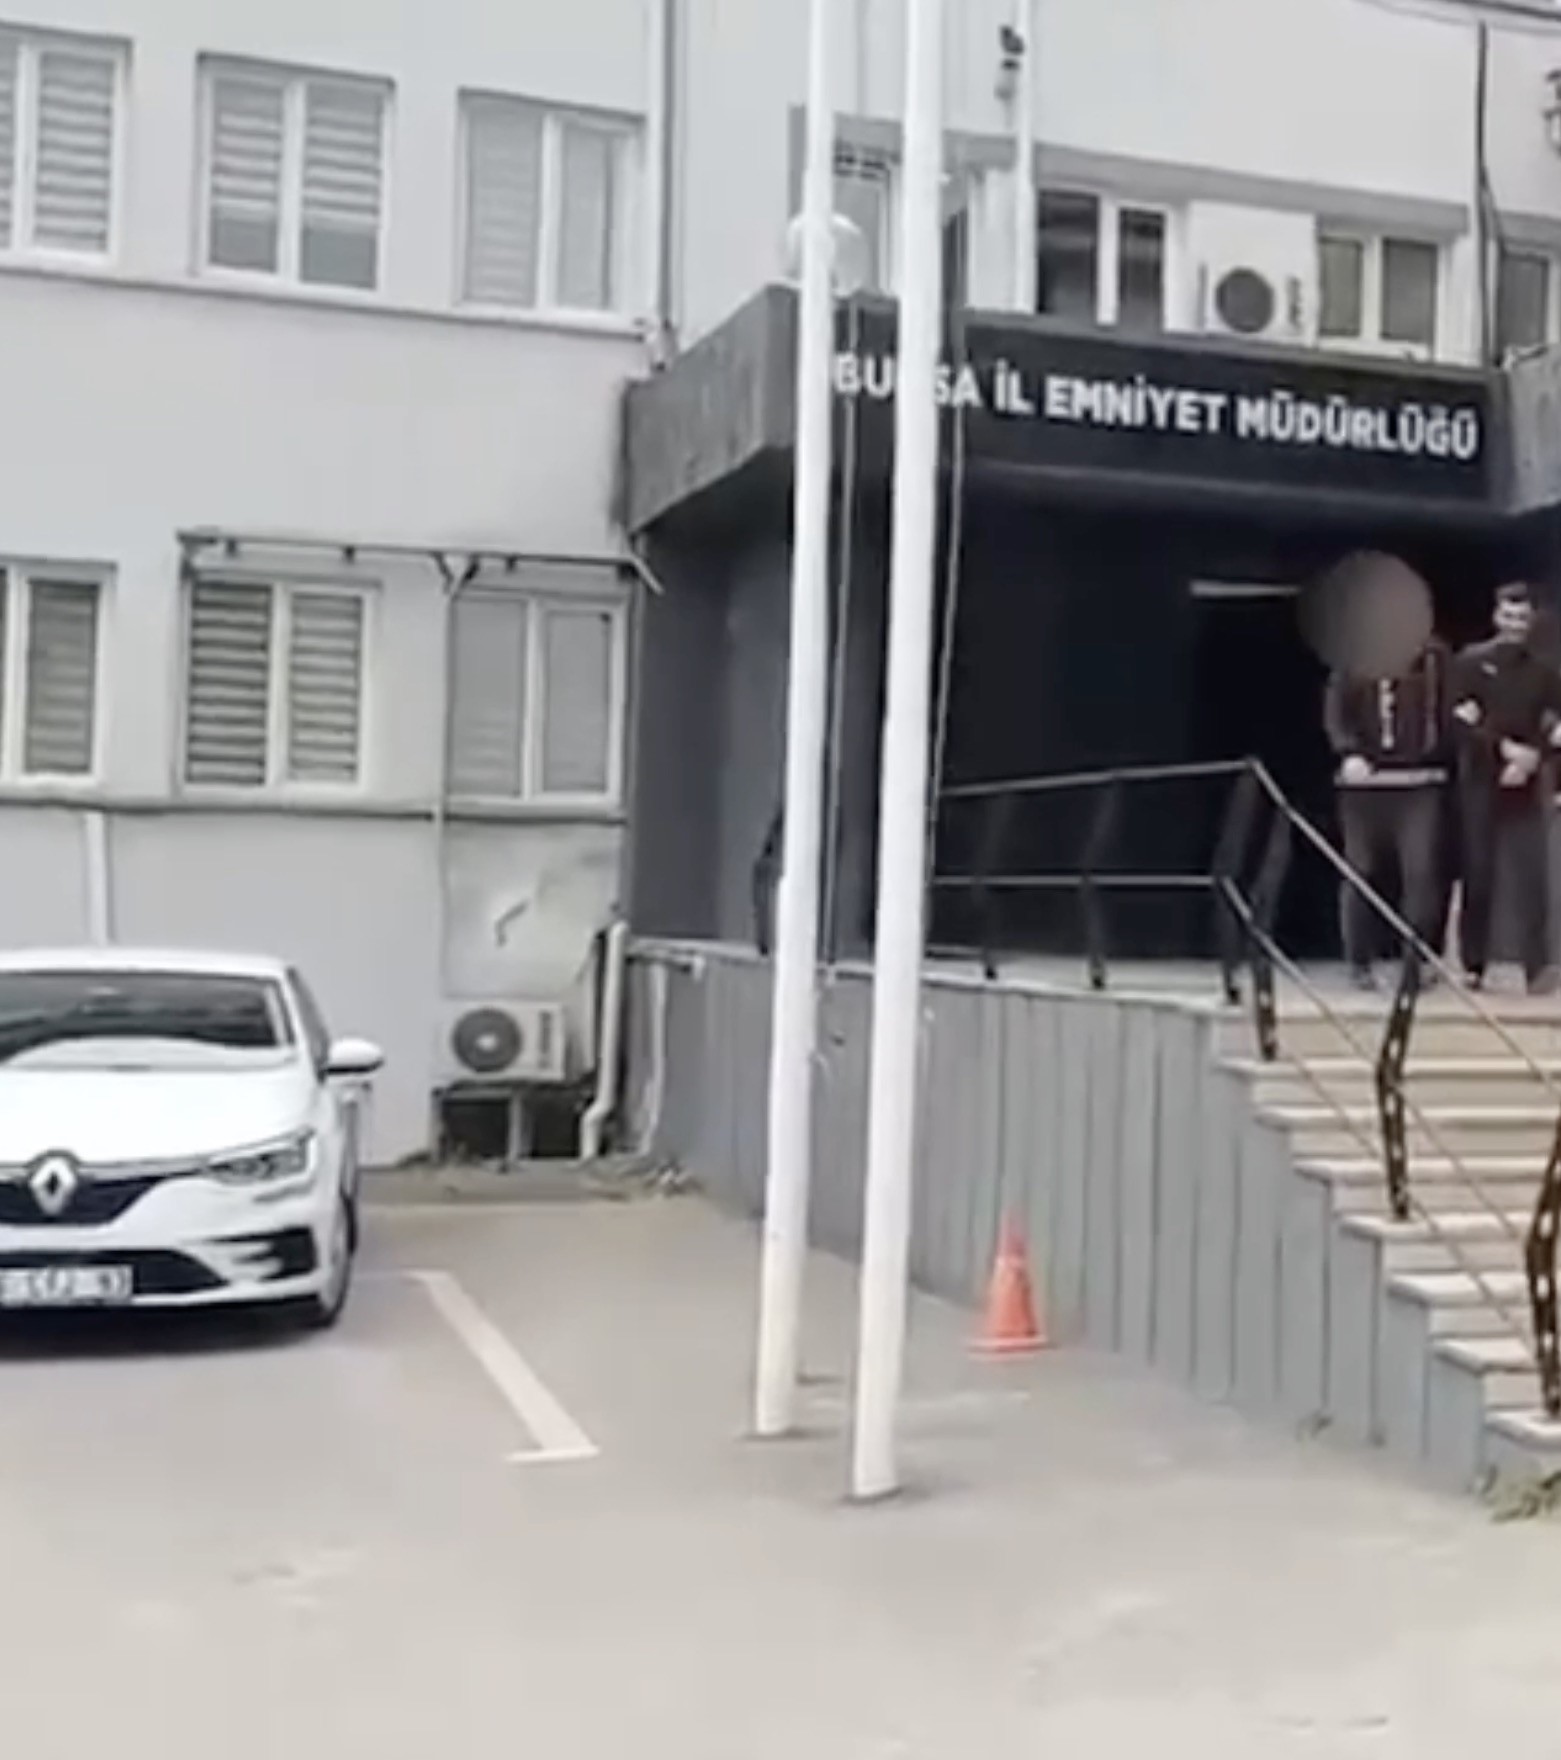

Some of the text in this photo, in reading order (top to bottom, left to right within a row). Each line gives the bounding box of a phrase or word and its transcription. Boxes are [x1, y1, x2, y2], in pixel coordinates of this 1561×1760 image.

[834, 352, 1479, 461] BUSA İL EMNİYET MÜDÜRLÜĞÜ
